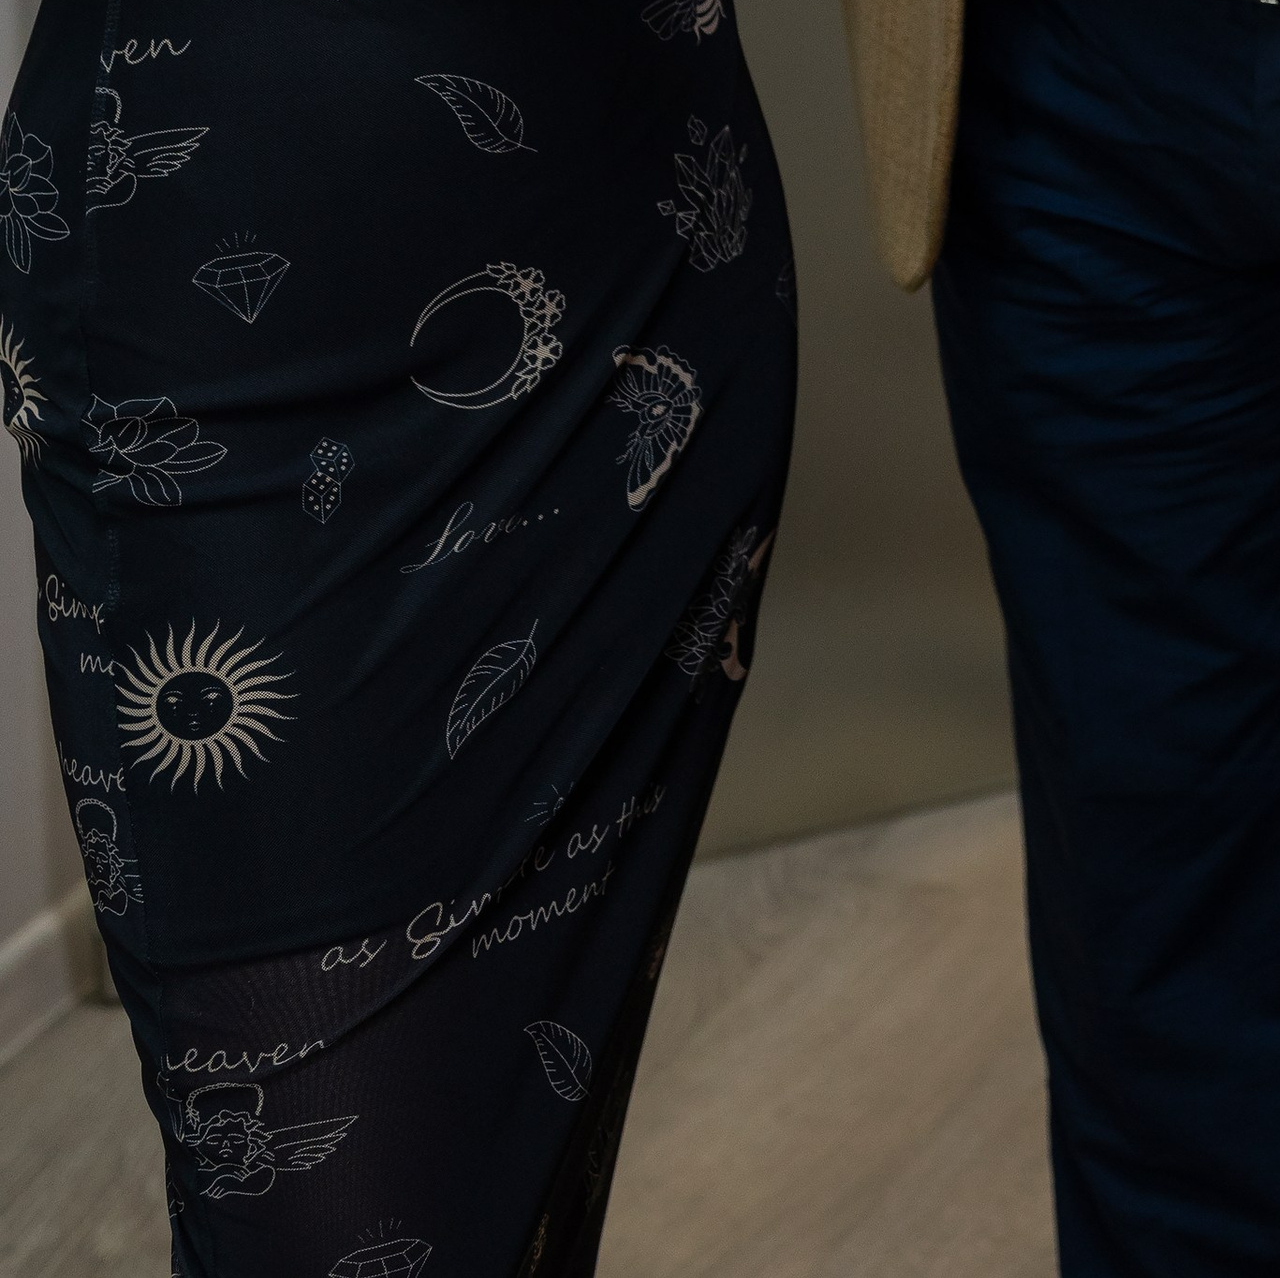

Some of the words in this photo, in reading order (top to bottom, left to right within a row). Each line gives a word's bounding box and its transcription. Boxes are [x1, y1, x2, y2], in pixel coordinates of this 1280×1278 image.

[320, 938, 387, 971] as
[567, 824, 610, 859] as
[472, 859, 617, 958] moment
